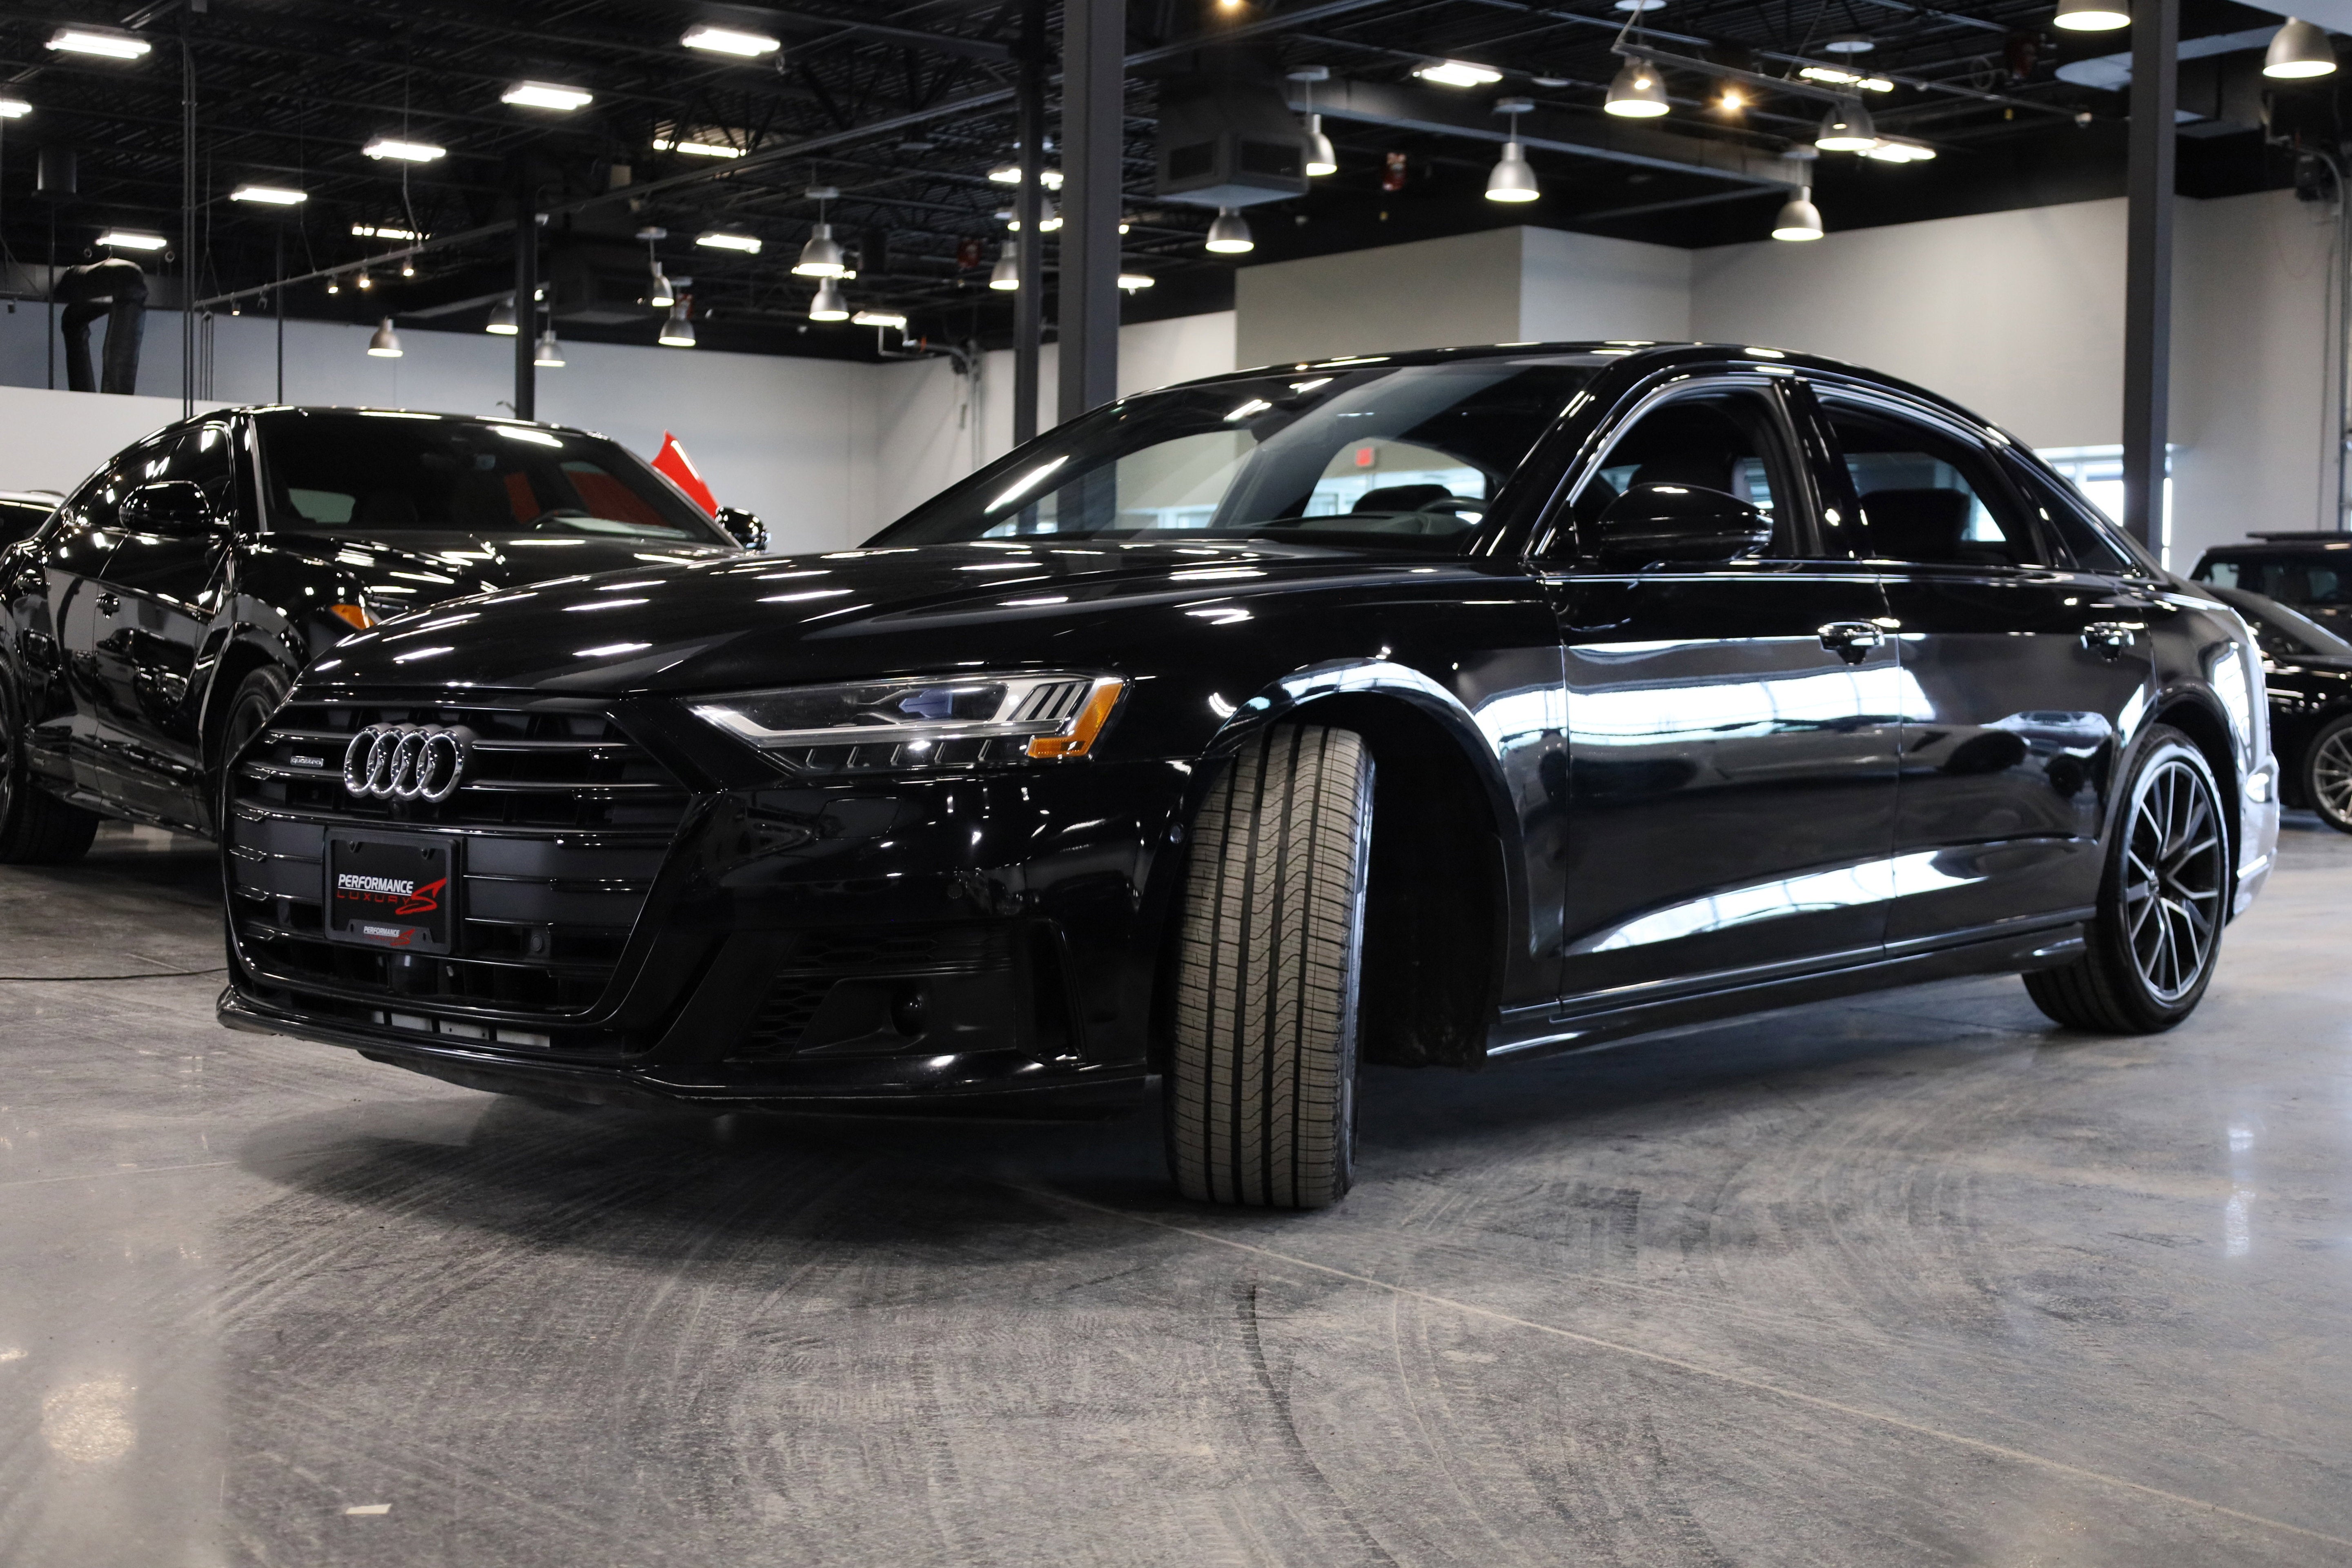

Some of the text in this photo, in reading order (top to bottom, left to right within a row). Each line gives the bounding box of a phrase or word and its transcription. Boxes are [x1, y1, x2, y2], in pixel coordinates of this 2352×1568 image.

[338, 873, 414, 894] PERFORMANCE
[336, 890, 410, 904] LUXURY
[363, 926, 400, 936] PERFORMANCE
